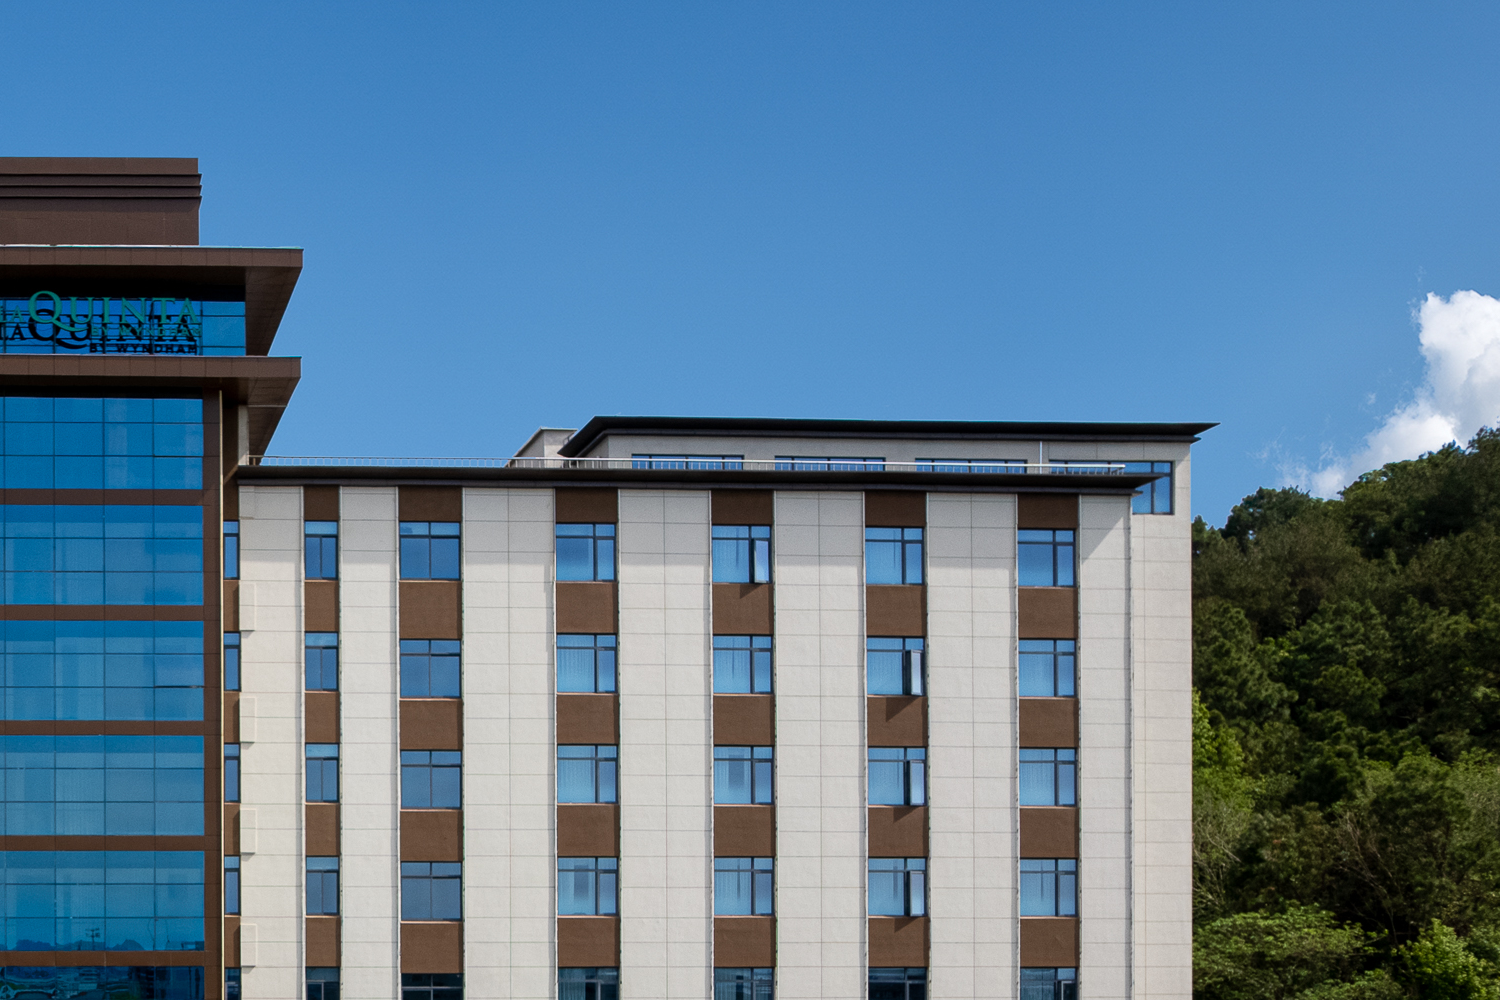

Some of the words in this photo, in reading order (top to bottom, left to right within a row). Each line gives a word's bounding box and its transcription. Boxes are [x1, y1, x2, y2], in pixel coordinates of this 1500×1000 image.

[27, 290, 201, 332] QUINTA
[91, 326, 109, 337] BY
[119, 326, 202, 338] WYNDHAM
